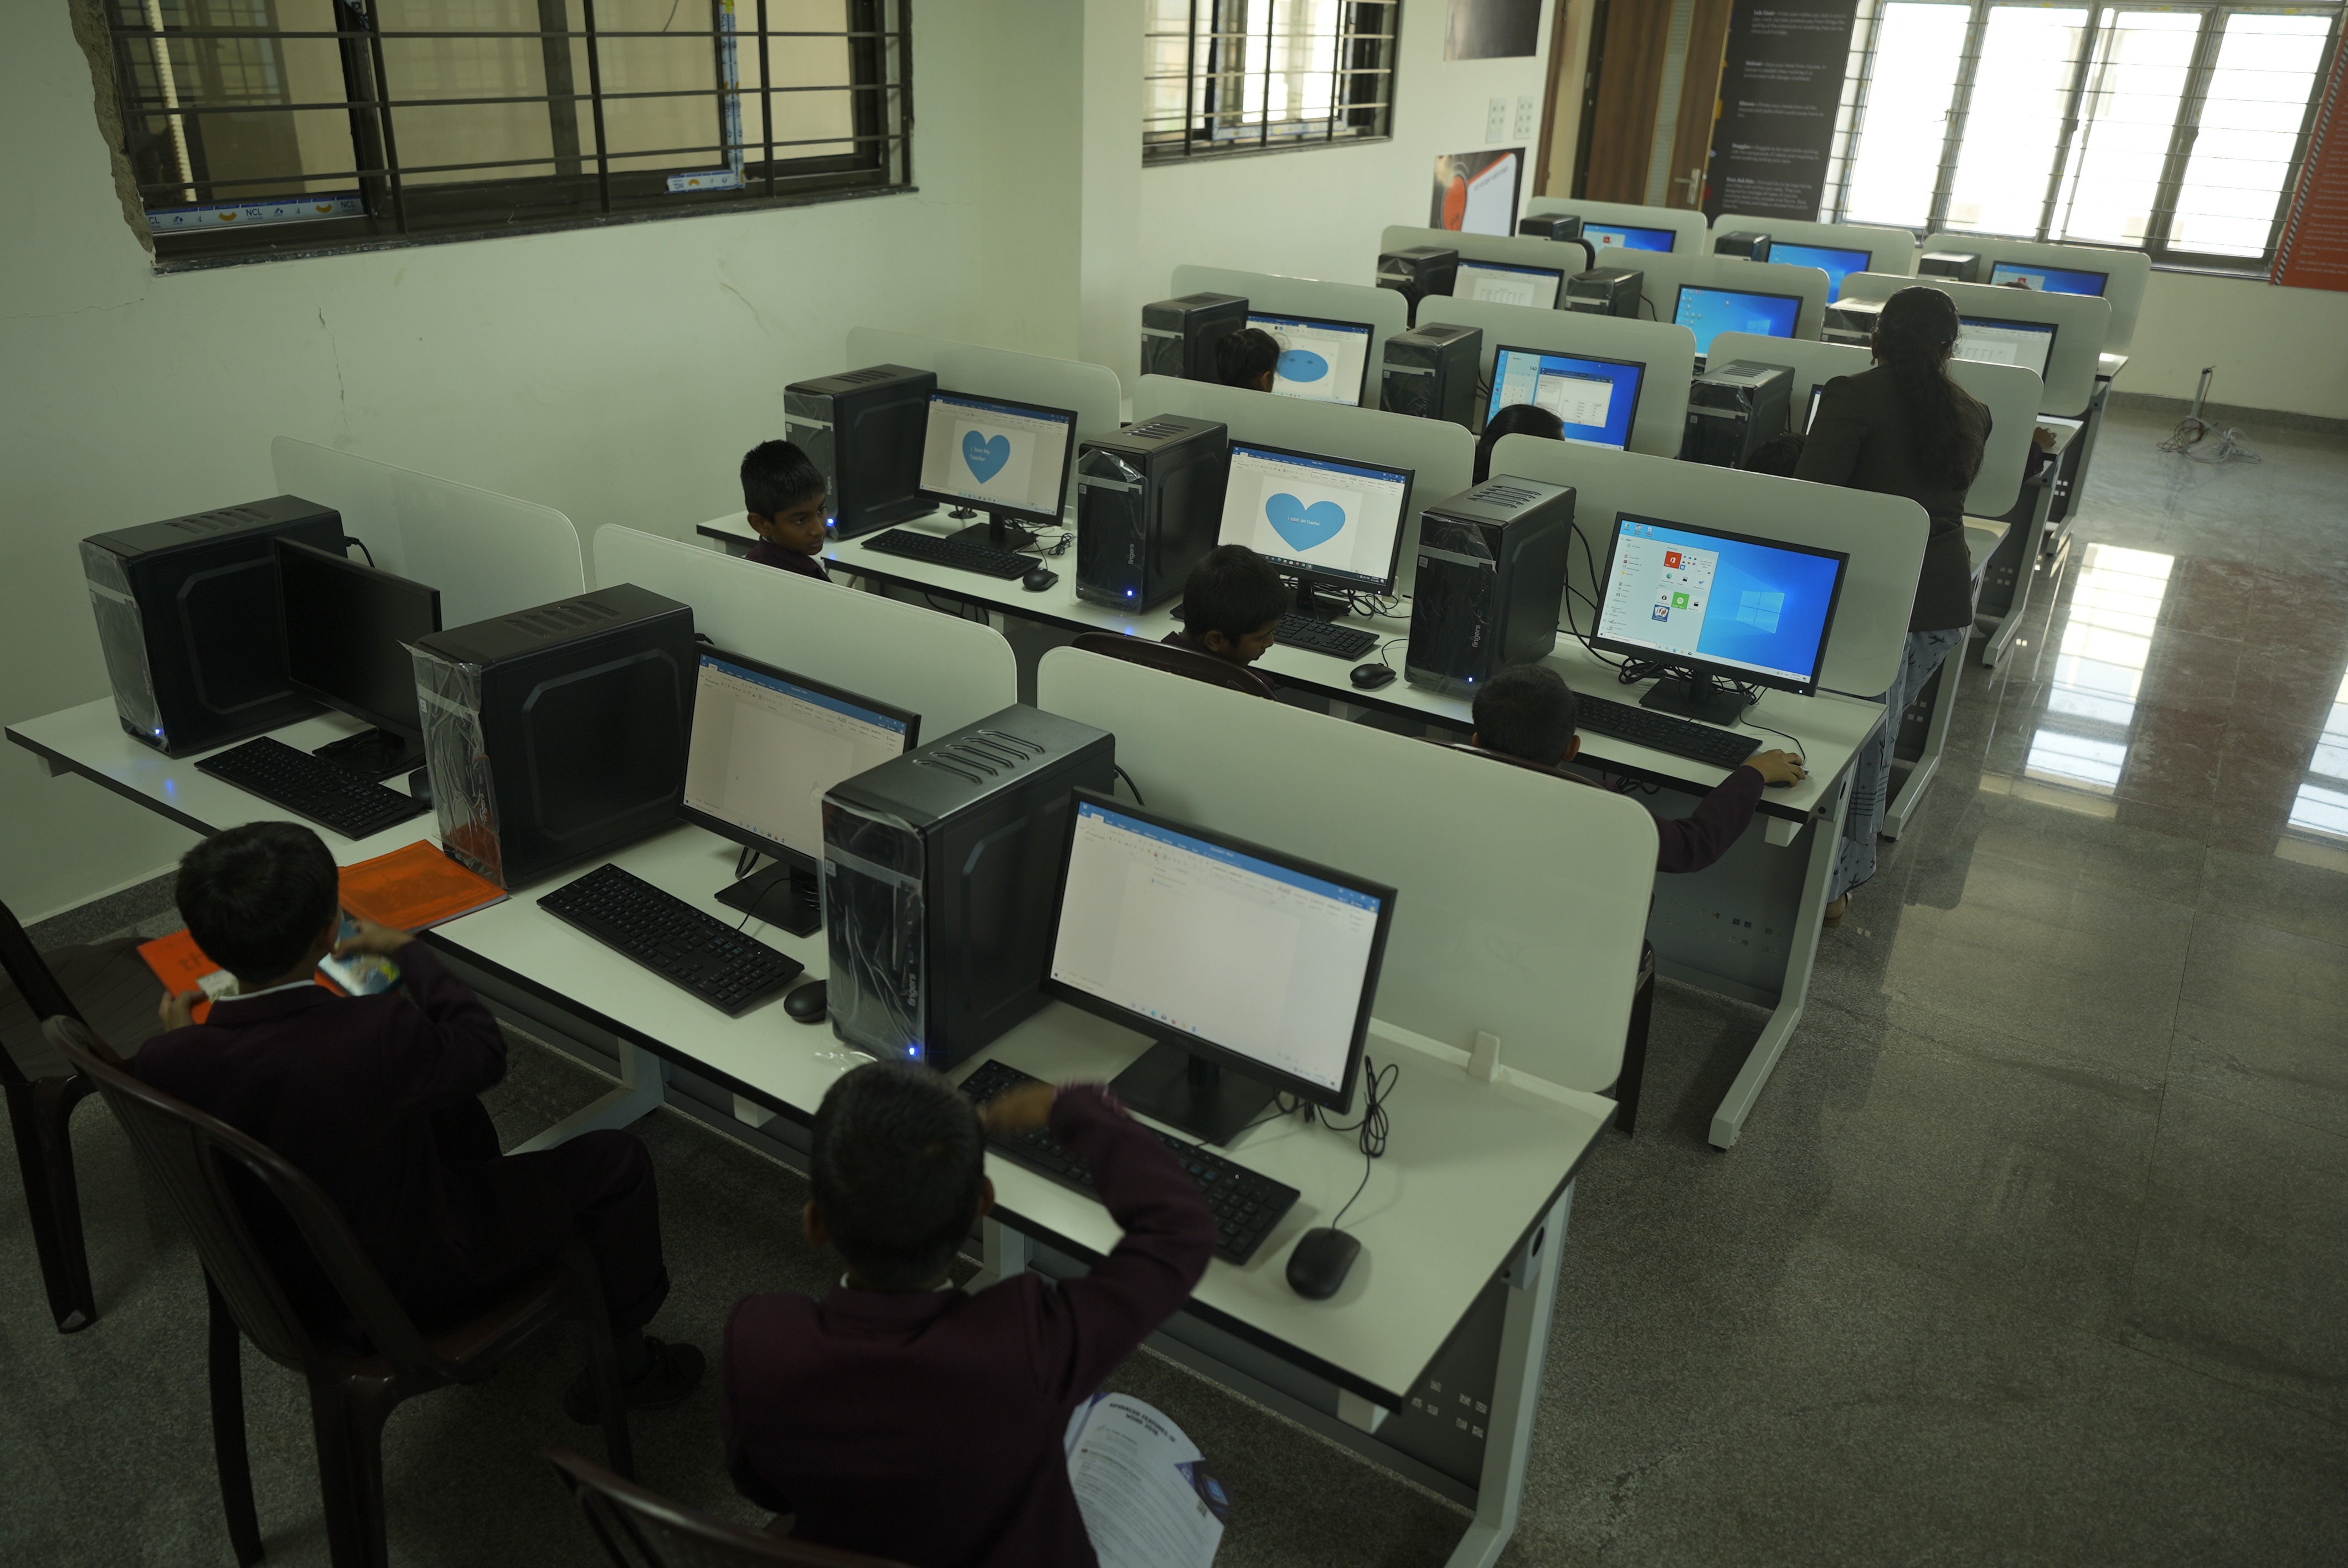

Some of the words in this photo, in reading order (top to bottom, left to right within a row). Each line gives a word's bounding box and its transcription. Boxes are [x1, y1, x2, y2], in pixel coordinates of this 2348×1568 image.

[245, 208, 262, 216] NCL
[340, 200, 356, 209] NCL
[1127, 543, 1136, 565] fingers
[1471, 624, 1481, 648] fingers
[143, 670, 152, 697] fingers
[480, 793, 488, 824] fingers
[907, 972, 918, 1007] fingers
[1142, 1414, 1168, 1437] FEATURES
